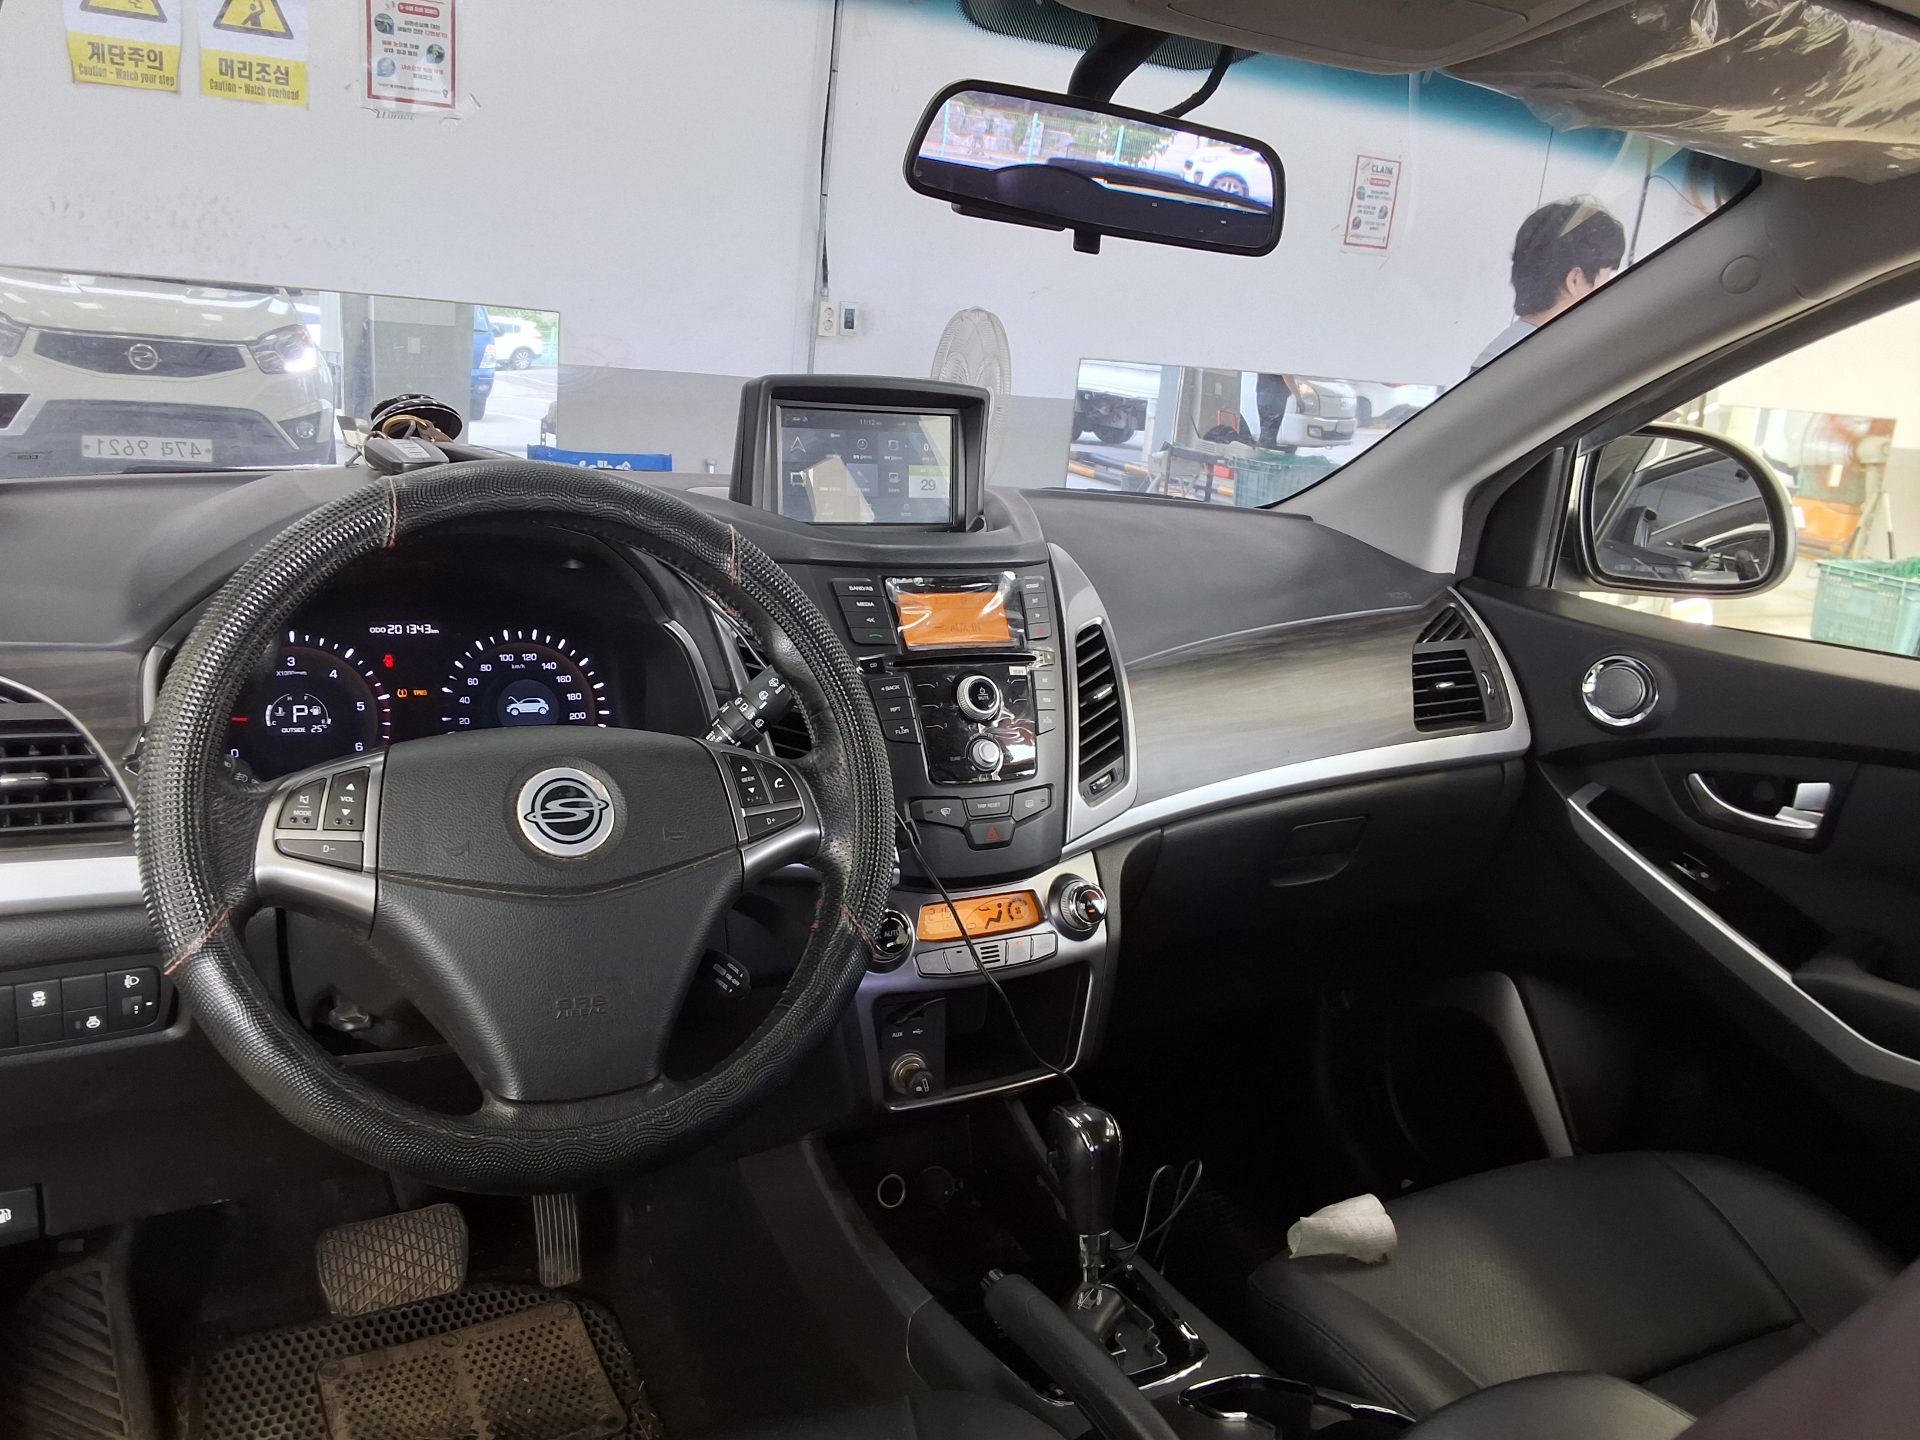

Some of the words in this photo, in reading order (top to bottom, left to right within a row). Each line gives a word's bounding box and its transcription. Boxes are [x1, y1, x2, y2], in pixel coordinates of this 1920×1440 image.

[87, 41, 164, 72] 계단주의
[78, 63, 108, 78] Caution
[115, 67, 139, 82] Watch
[140, 71, 157, 84] your
[158, 74, 176, 88] step
[218, 57, 290, 87] 머리조심
[208, 78, 237, 93] Caution
[243, 82, 266, 97] Watch
[267, 86, 300, 101] overhead
[1371, 164, 1394, 176] CLAIM
[920, 478, 937, 492] 29
[369, 626, 387, 634] ODO
[286, 656, 296, 667] 3
[499, 653, 514, 662] 100
[521, 653, 538, 661] 120
[480, 663, 492, 672] 80
[541, 662, 557, 670] 140
[329, 669, 338, 679] 4
[556, 674, 572, 683] 160
[467, 677, 479, 686] 60
[459, 696, 471, 704] 40
[566, 692, 582, 701] 180
[356, 701, 365, 711] 5
[292, 704, 309, 724] P
[569, 711, 587, 721] 200
[459, 717, 471, 725] 20
[281, 726, 306, 734] OUTSIDE
[355, 742, 364, 752] 6
[230, 748, 240, 758] 0
[293, 809, 312, 817] MODE
